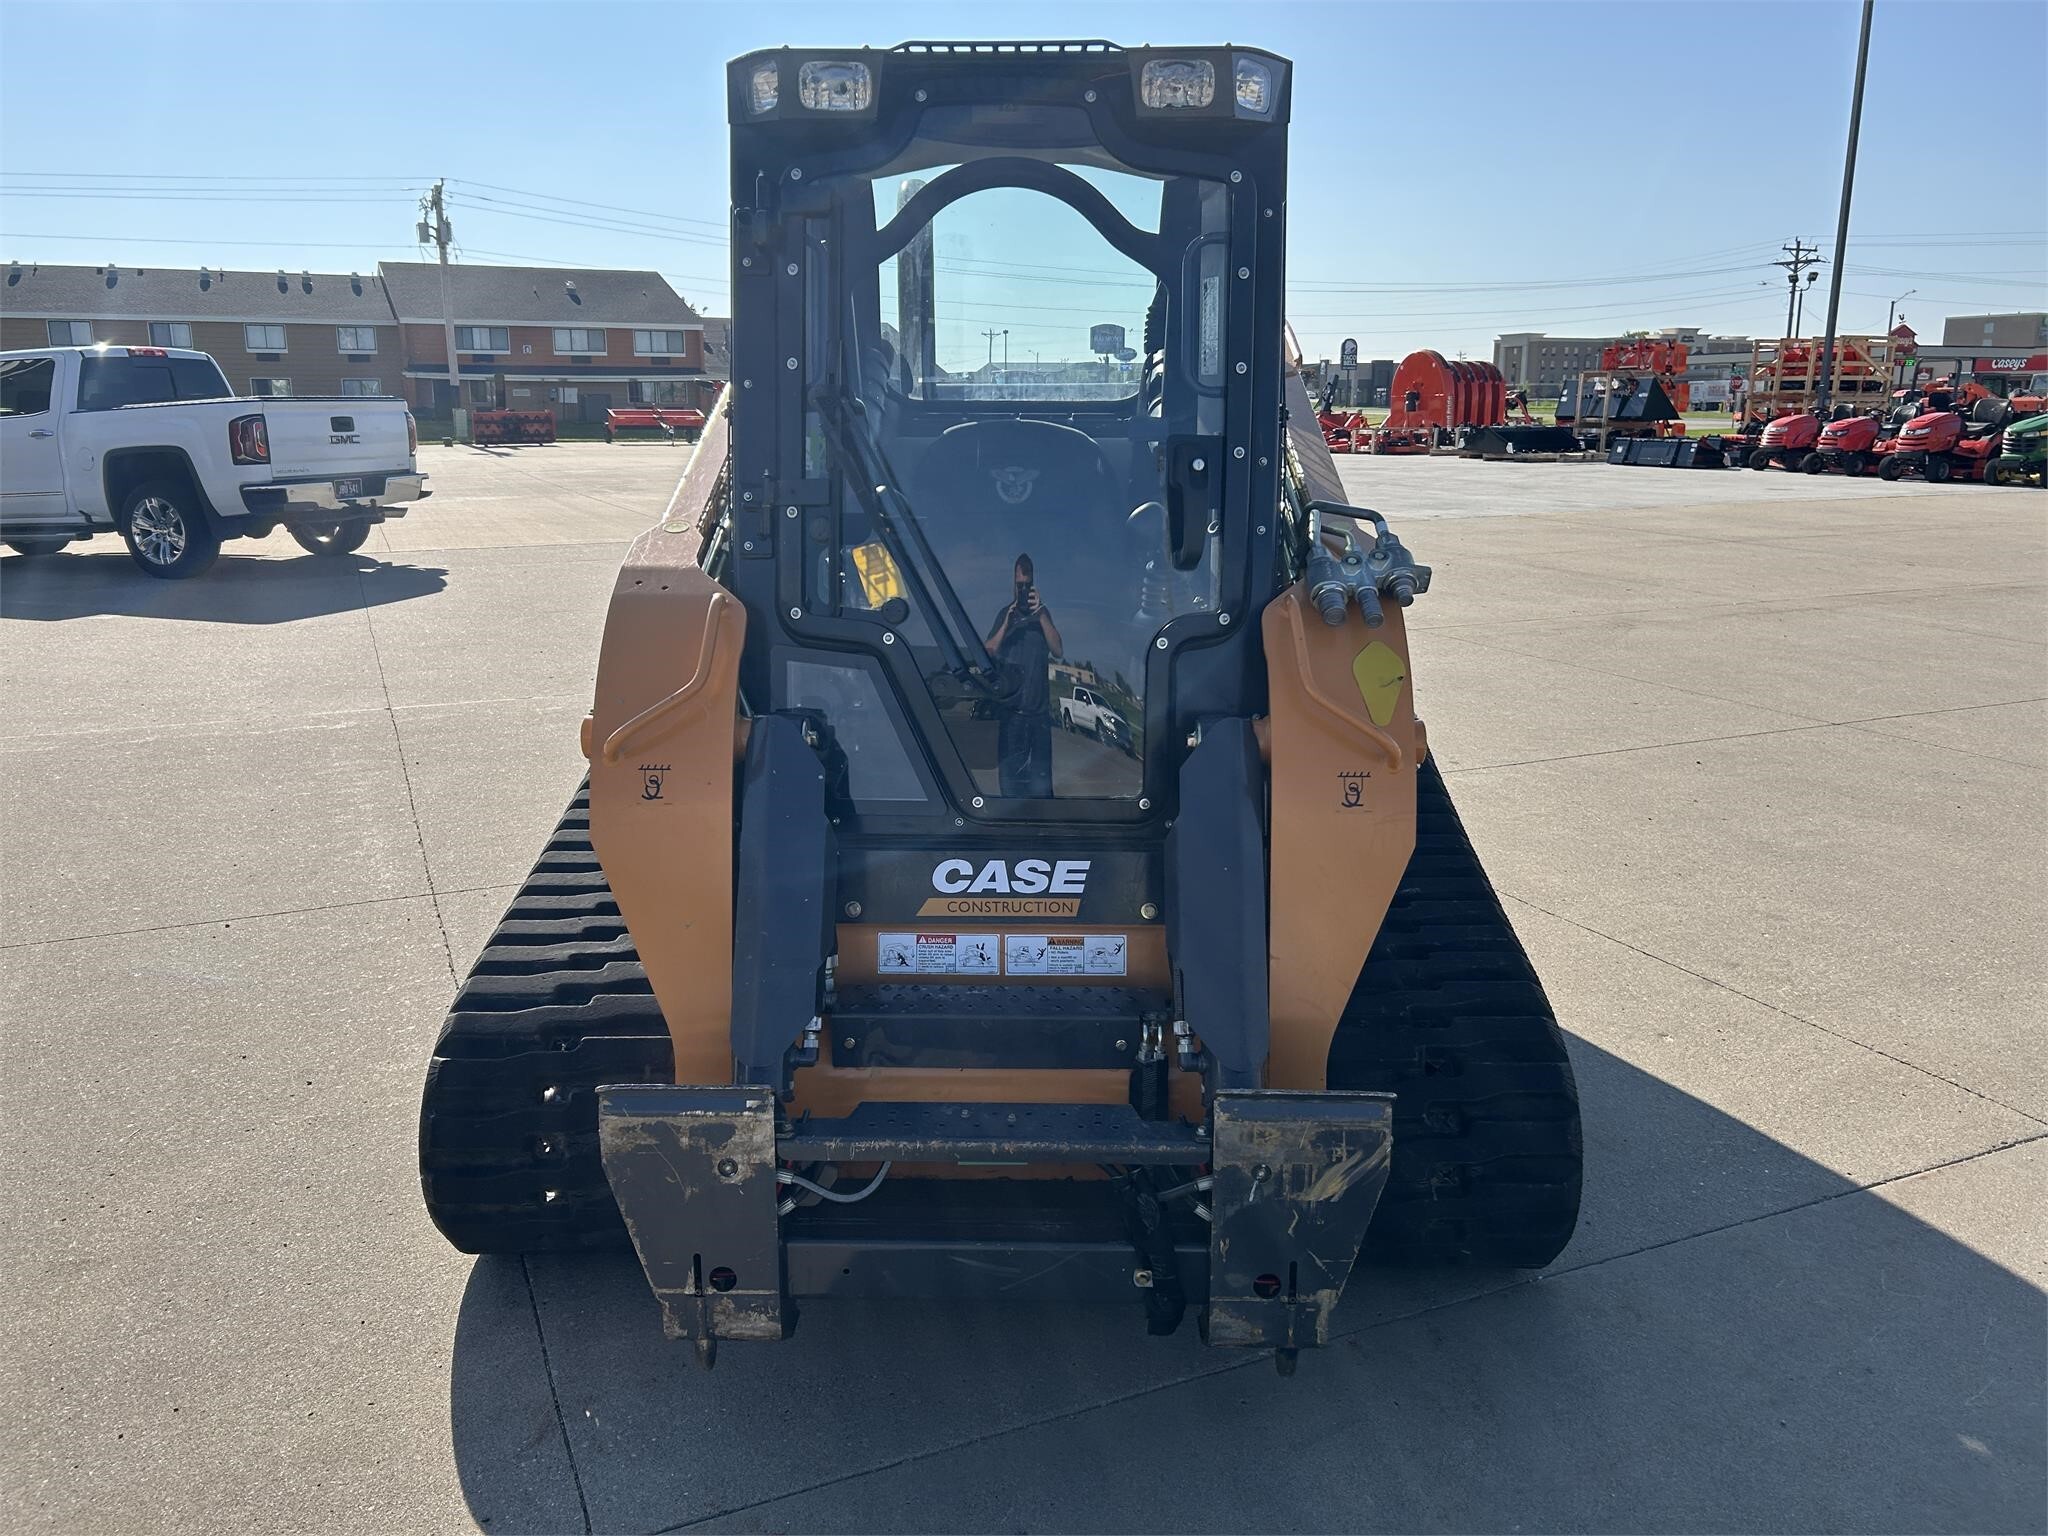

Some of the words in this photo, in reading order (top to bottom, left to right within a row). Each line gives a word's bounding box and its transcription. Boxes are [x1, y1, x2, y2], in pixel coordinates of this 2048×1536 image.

[330, 435, 360, 444] GMC
[932, 859, 1091, 894] CASE
[947, 901, 1073, 914] CONSTRUCTION
